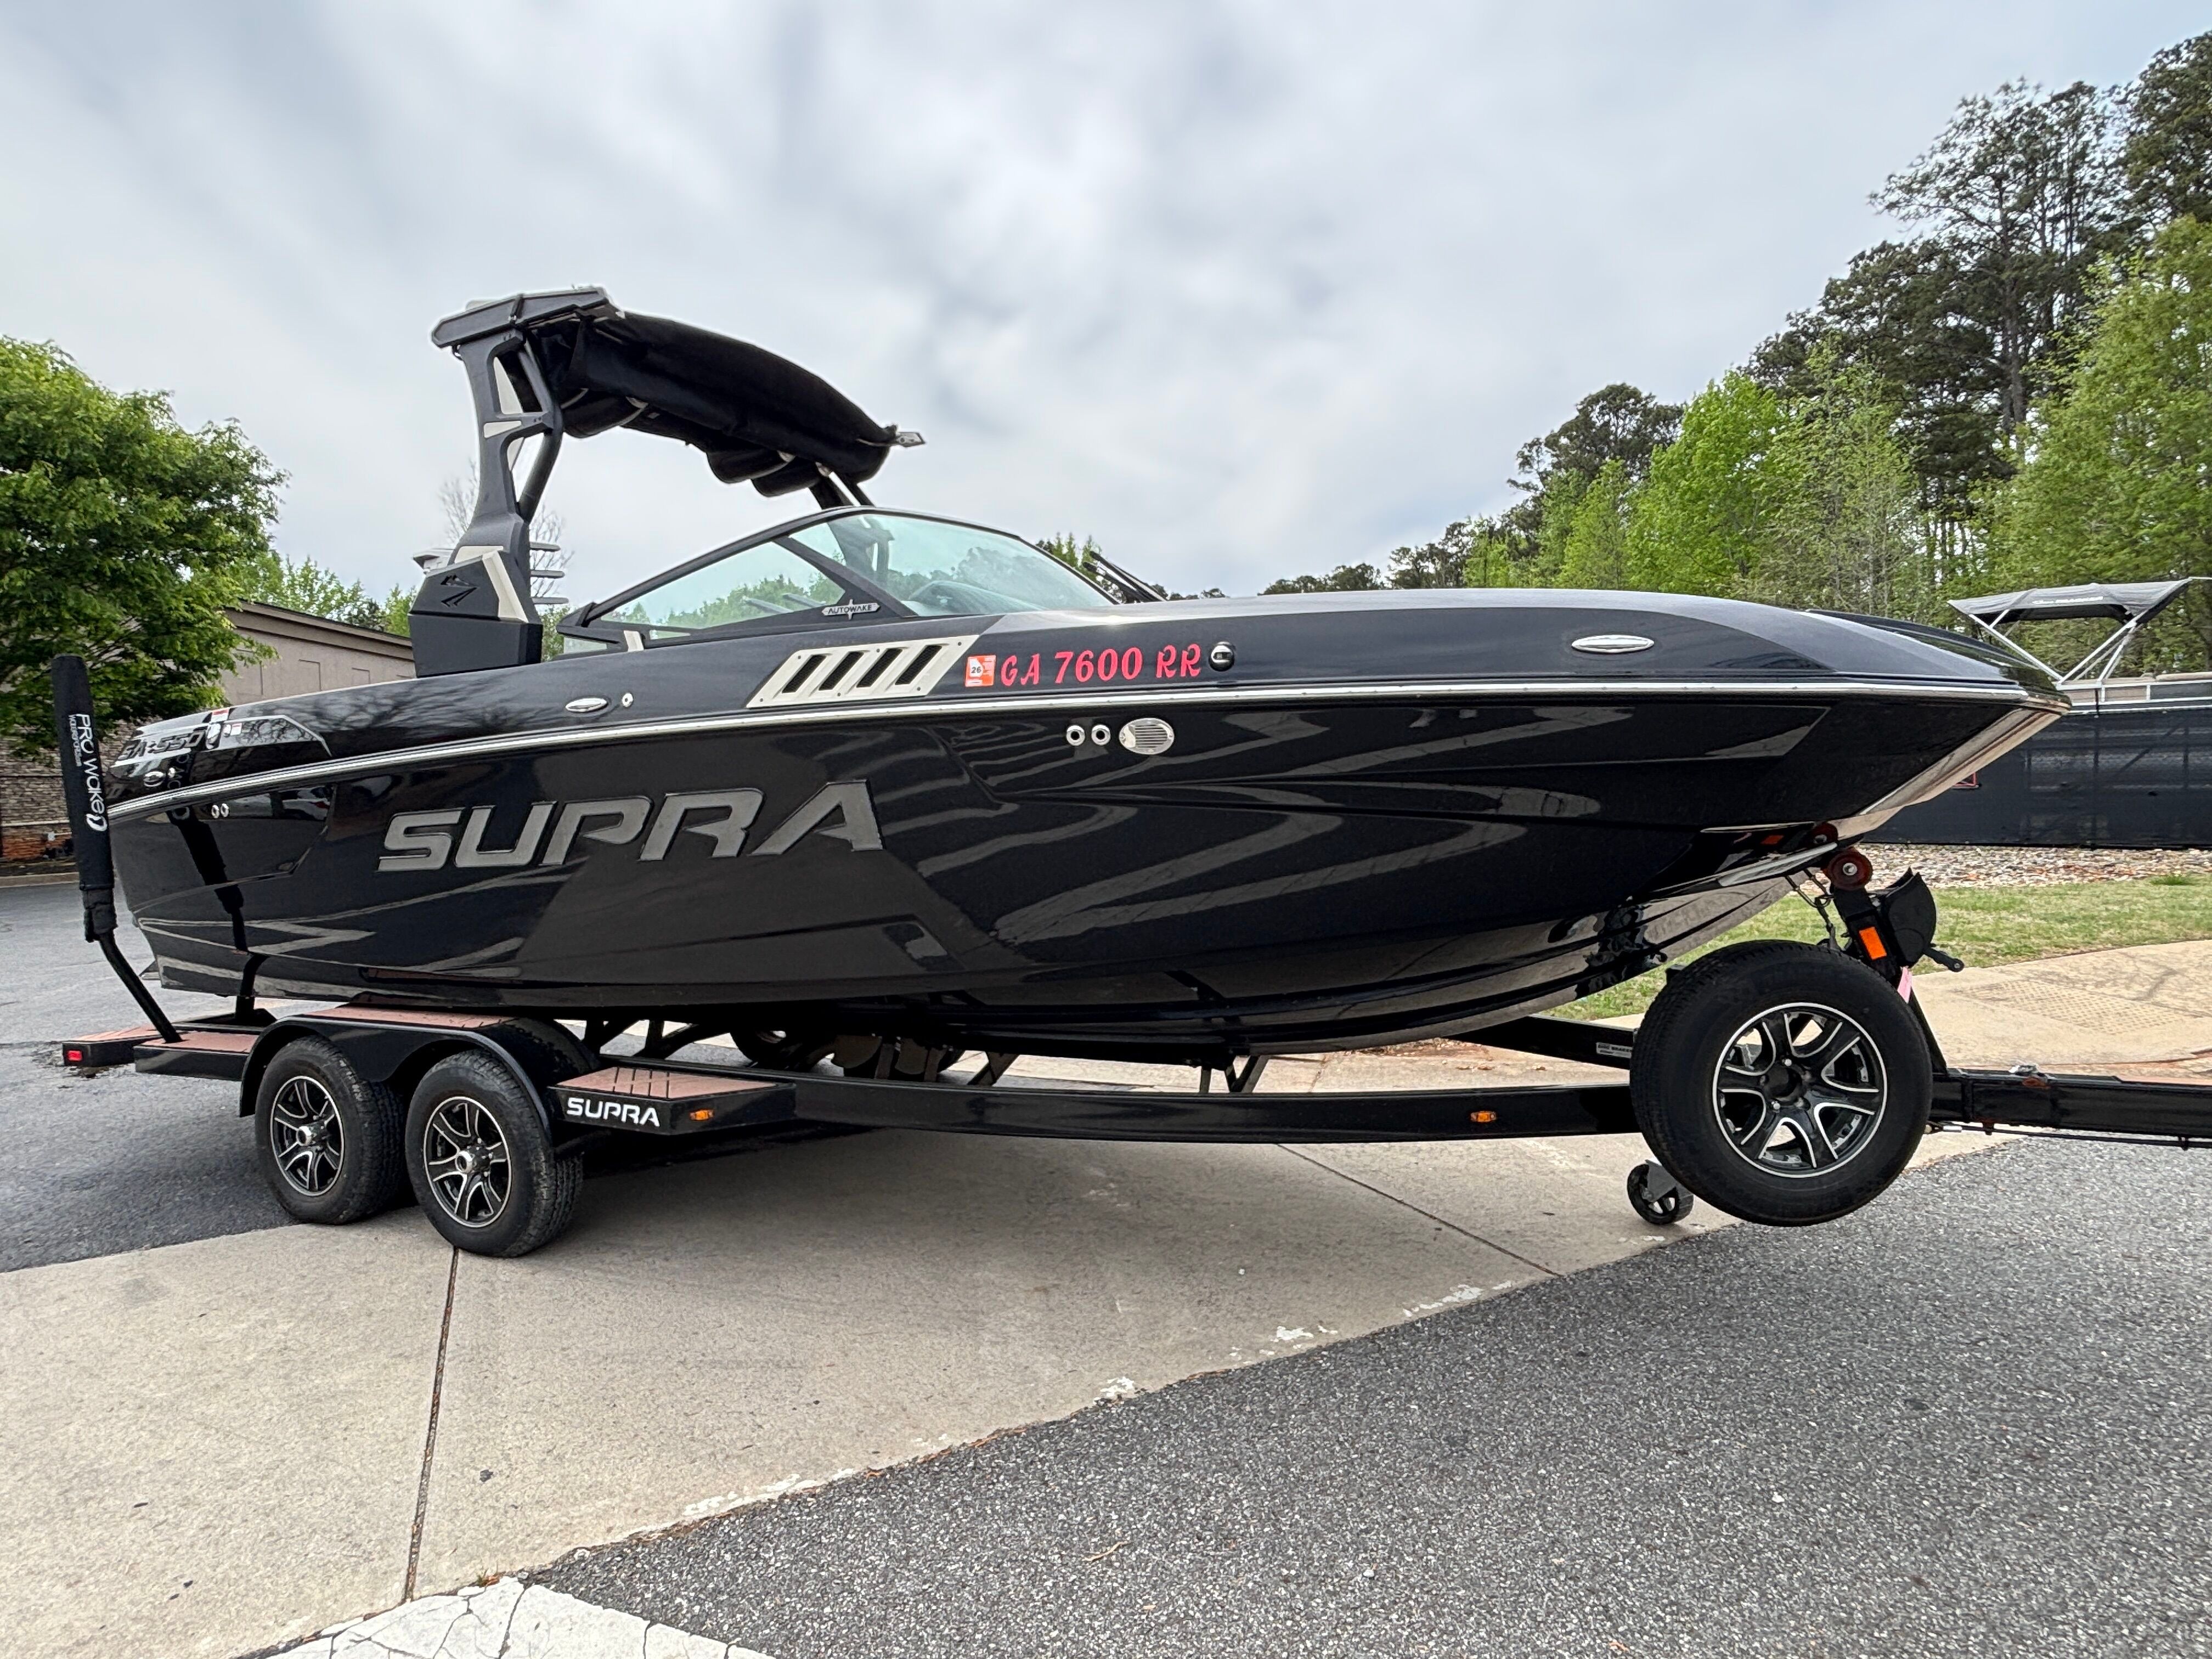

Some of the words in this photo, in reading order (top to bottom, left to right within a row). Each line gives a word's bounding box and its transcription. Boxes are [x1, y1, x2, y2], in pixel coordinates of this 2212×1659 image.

[828, 604, 872, 614] AUTOWAKE
[1000, 653, 1040, 686] GA
[1054, 647, 1143, 684] 7600
[1156, 643, 1202, 679] RR
[376, 778, 884, 872] SUPRA
[566, 1097, 660, 1127] SUPRA
